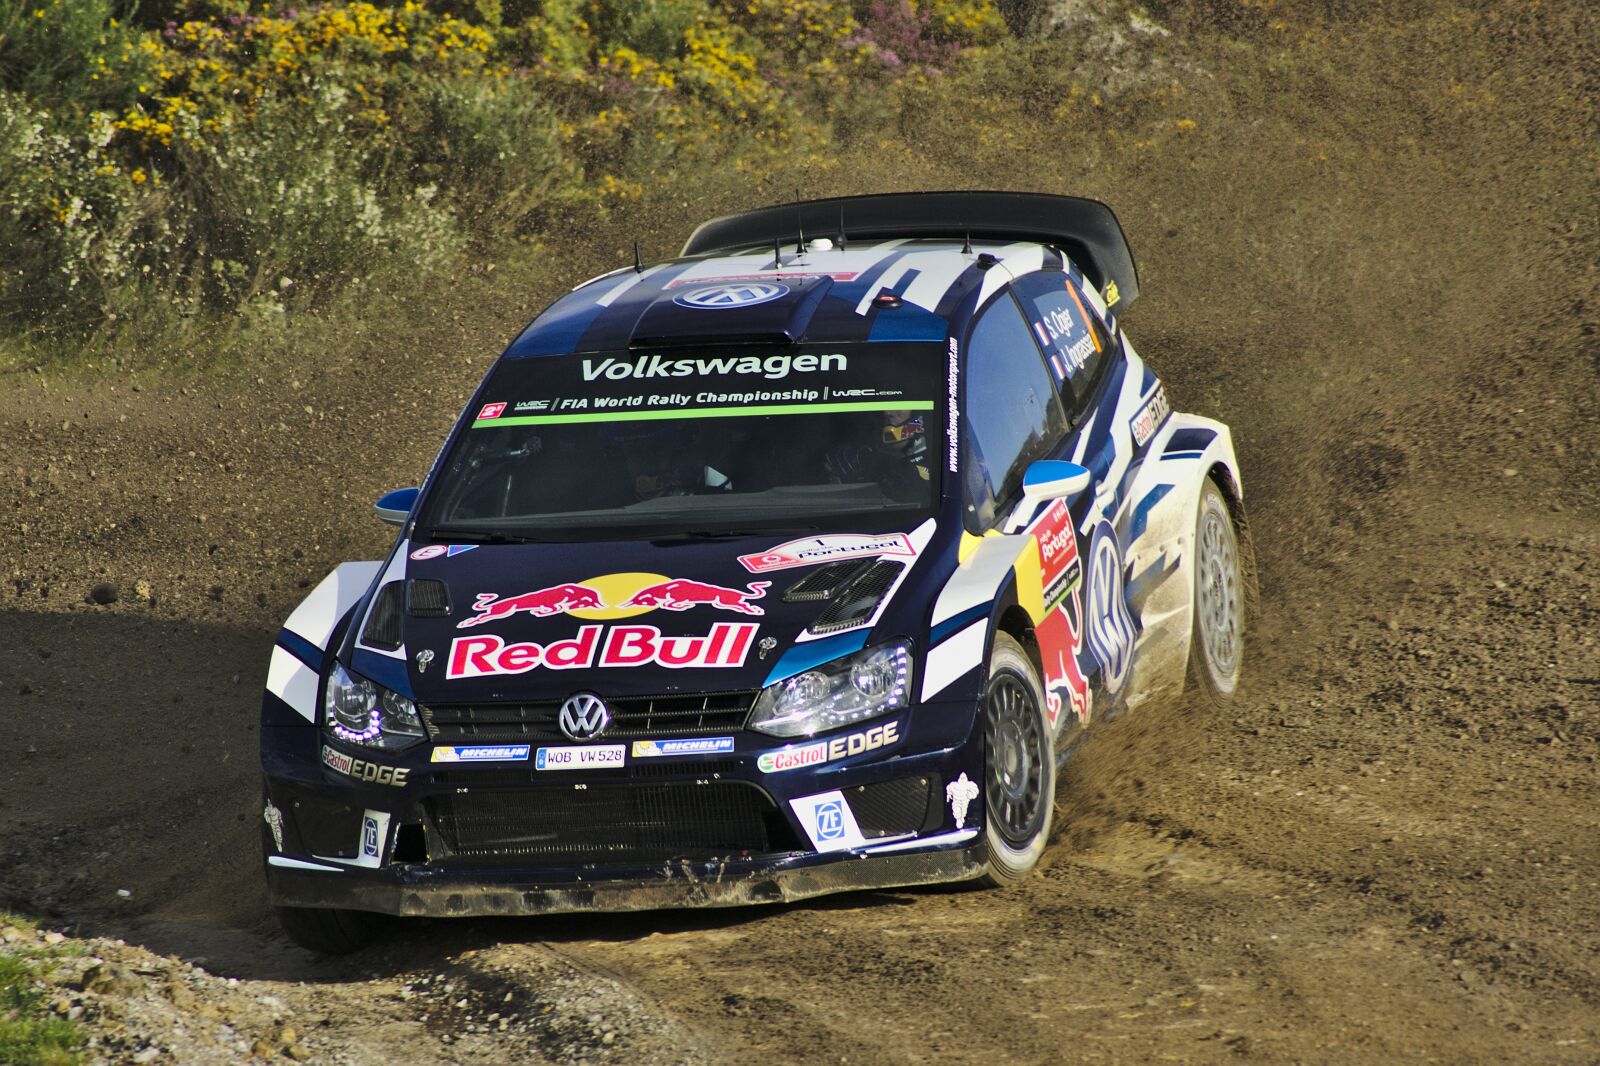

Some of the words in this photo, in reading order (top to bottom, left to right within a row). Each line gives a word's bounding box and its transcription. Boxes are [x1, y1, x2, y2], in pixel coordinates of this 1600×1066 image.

[582, 353, 848, 381] Volkswagen
[560, 398, 588, 410] FIA
[594, 395, 643, 408] World
[647, 392, 691, 406] Rally
[696, 389, 819, 403] Championship
[947, 336, 959, 472] www.volkswagen-motorsport.com
[449, 626, 601, 677] Red
[602, 624, 757, 667] Bull
[461, 746, 528, 759] MICHELIN
[548, 751, 572, 764] WOB
[662, 739, 732, 751] MICHELIN
[775, 746, 825, 769] Castrol
[828, 721, 900, 761] EDGE
[326, 749, 350, 774] Castrol
[351, 759, 411, 787] EDGE
[818, 808, 842, 834] ZF
